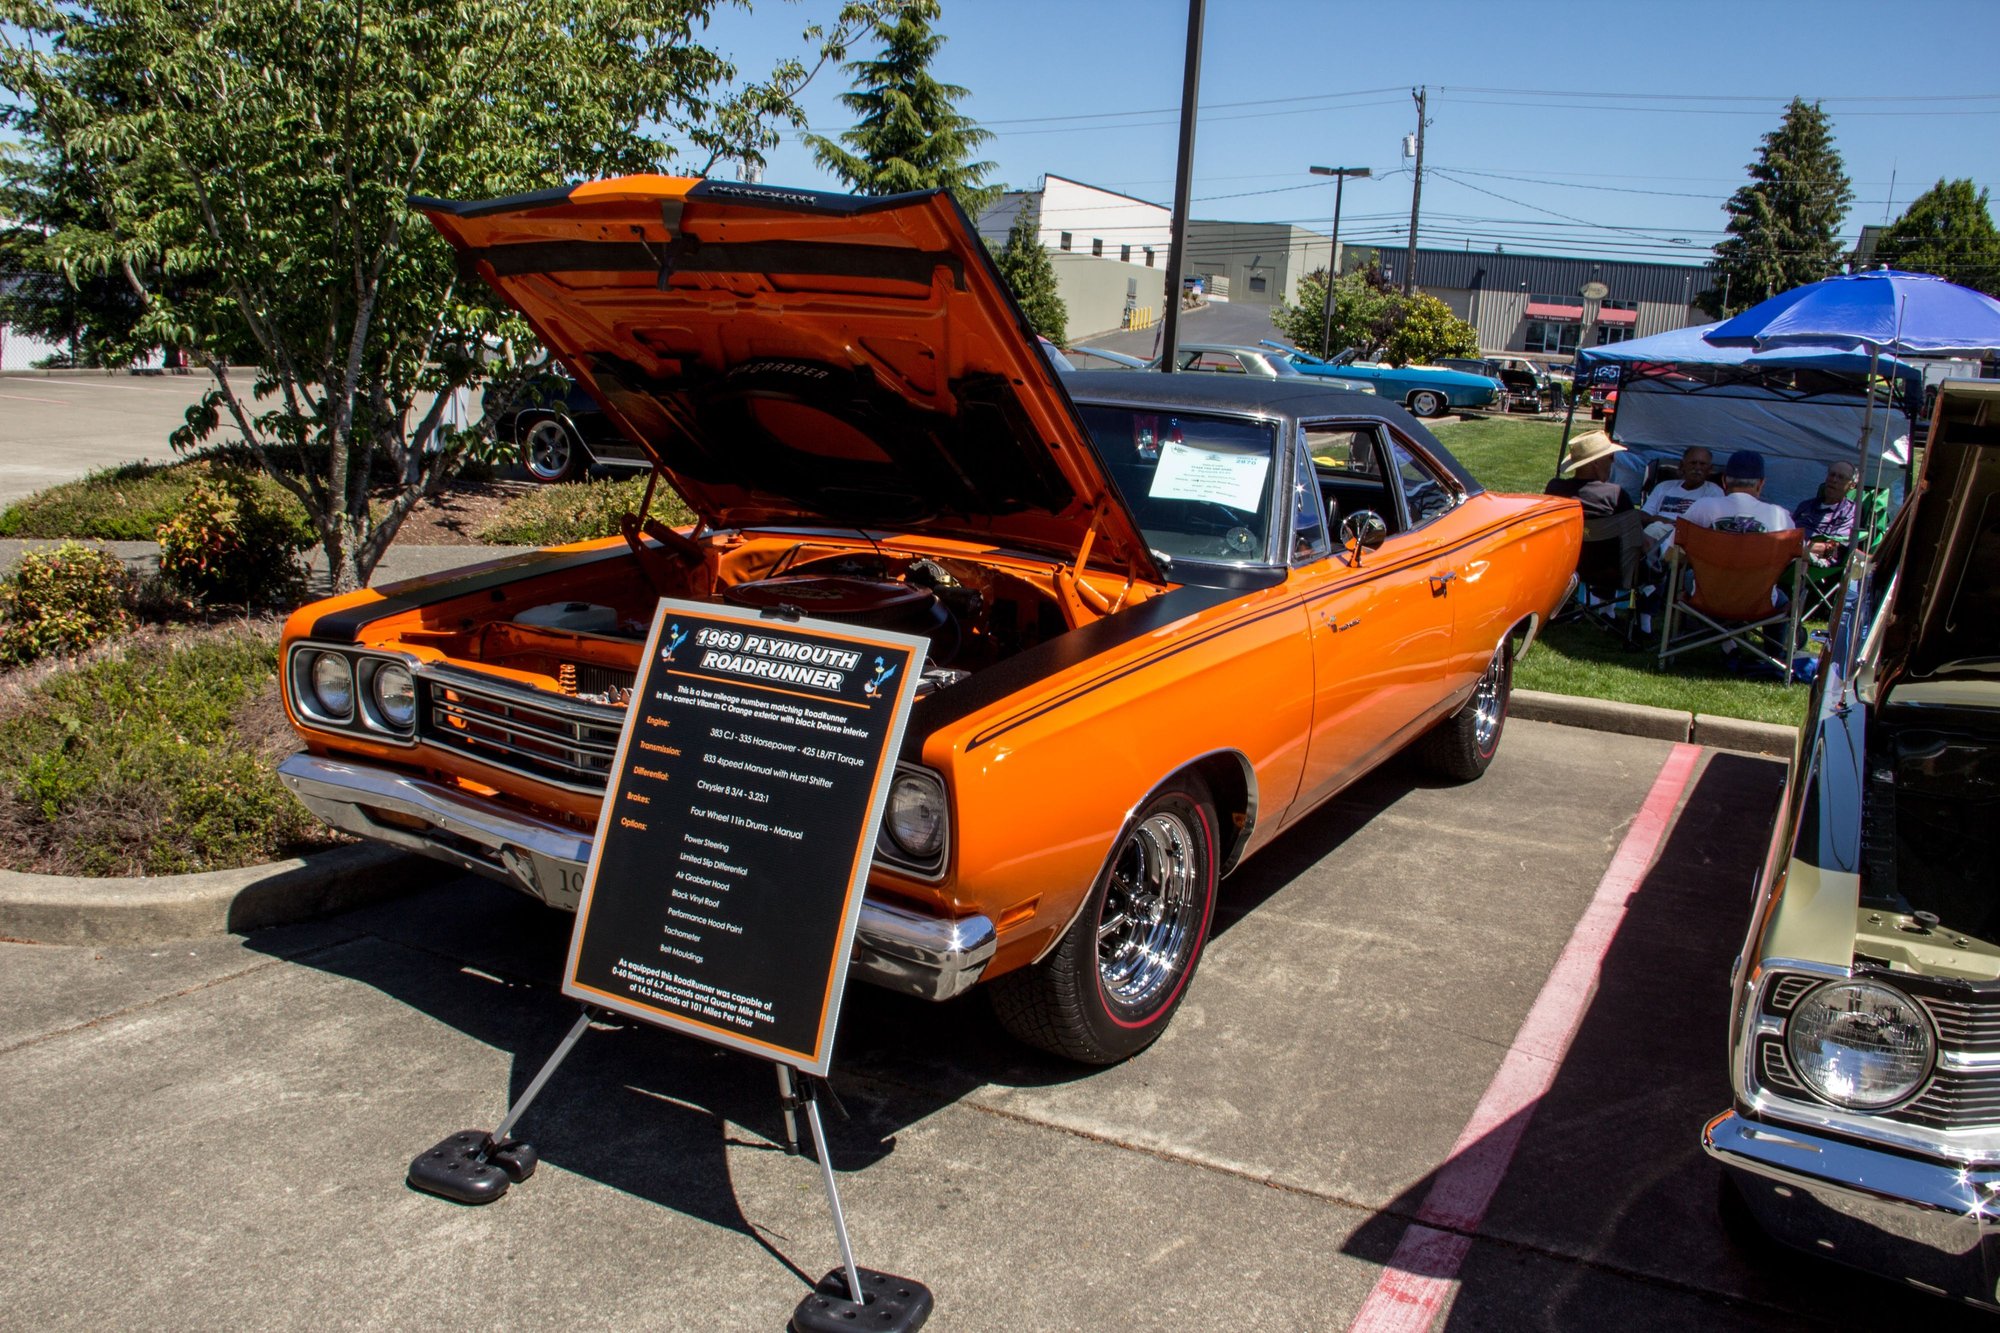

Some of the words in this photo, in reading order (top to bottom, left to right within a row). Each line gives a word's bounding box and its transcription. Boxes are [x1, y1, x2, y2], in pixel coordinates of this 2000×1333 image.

[750, 362, 828, 379] GRABBER
[697, 629, 742, 651] 1969
[742, 635, 861, 670] PLYMOUTH
[701, 651, 843, 691] ROADRUNNER
[662, 692, 673, 701] the
[673, 695, 696, 705] correct
[696, 698, 721, 710] Vitamin
[720, 703, 728, 711] C
[727, 704, 753, 717] Orange
[753, 710, 780, 721] exterior
[780, 714, 795, 724] with
[795, 717, 816, 728] black
[816, 721, 842, 733] Deluxe
[842, 726, 869, 738] interior
[678, 685, 690, 695] This
[689, 687, 695, 696] is
[701, 689, 714, 698] low
[713, 692, 740, 704] mileage
[740, 698, 770, 709] numbers
[770, 703, 804, 717] matching
[804, 708, 848, 724] RoadRunner
[646, 715, 670, 727] Engine:
[640, 740, 682, 756] Transmission:
[710, 728, 724, 738] 383
[738, 733, 753, 744] 335
[752, 736, 797, 753] Horsepower
[801, 746, 816, 757] 425
[816, 749, 837, 761] LB/FT
[837, 753, 865, 767] Torque
[633, 766, 669, 781] Differential:
[703, 753, 717, 764] 833
[717, 757, 744, 770] 4speed
[744, 762, 773, 775] Manual
[773, 769, 789, 779] with
[789, 772, 809, 783] Hurst
[808, 775, 834, 788] Shifter
[626, 791, 650, 804] Brakes:
[697, 780, 725, 793] Chrysler
[724, 786, 731, 795] 8
[730, 787, 744, 797] 3/4
[748, 791, 769, 803] 3.23:1
[620, 817, 647, 831] Options:
[690, 806, 706, 817] Four
[707, 810, 730, 822] Wheel
[745, 819, 768, 832] Drums
[773, 826, 804, 840] Manual
[684, 834, 704, 845] Power
[704, 838, 730, 853] Steering
[680, 852, 703, 864] Limited
[702, 858, 714, 868] Slip
[713, 860, 748, 876] Differential
[675, 871, 685, 879] Air
[685, 873, 712, 886] Grabber
[711, 880, 730, 891] Hood
[671, 888, 689, 900] Black
[690, 893, 705, 905] Vinyl
[704, 897, 720, 908] Roof
[667, 907, 707, 925] Performance
[707, 918, 726, 930] Hood
[726, 923, 743, 934] Paint
[664, 925, 701, 942] Tachometer
[672, 948, 704, 964] Mouldings
[612, 966, 628, 978] 0-60
[627, 971, 645, 984] times
[645, 978, 654, 986] of
[653, 979, 665, 989] 6.7
[664, 984, 694, 999] seconds
[694, 993, 710, 1003] and
[710, 996, 738, 1012] Quarter
[737, 1005, 754, 1017] Mile
[754, 1010, 775, 1024] times
[618, 958, 628, 968] As
[628, 962, 661, 978] equipped
[660, 970, 673, 982] this
[673, 974, 716, 994] RoadRunner
[716, 988, 731, 999] was
[731, 993, 763, 1008] capable
[763, 1002, 773, 1011] of
[629, 983, 638, 992] of
[638, 985, 652, 997] 14.3
[651, 991, 681, 1006] seconds
[690, 1001, 702, 1012] 101
[702, 1005, 722, 1019] Miles
[722, 1011, 735, 1022] Per
[735, 1015, 754, 1028] Hour
